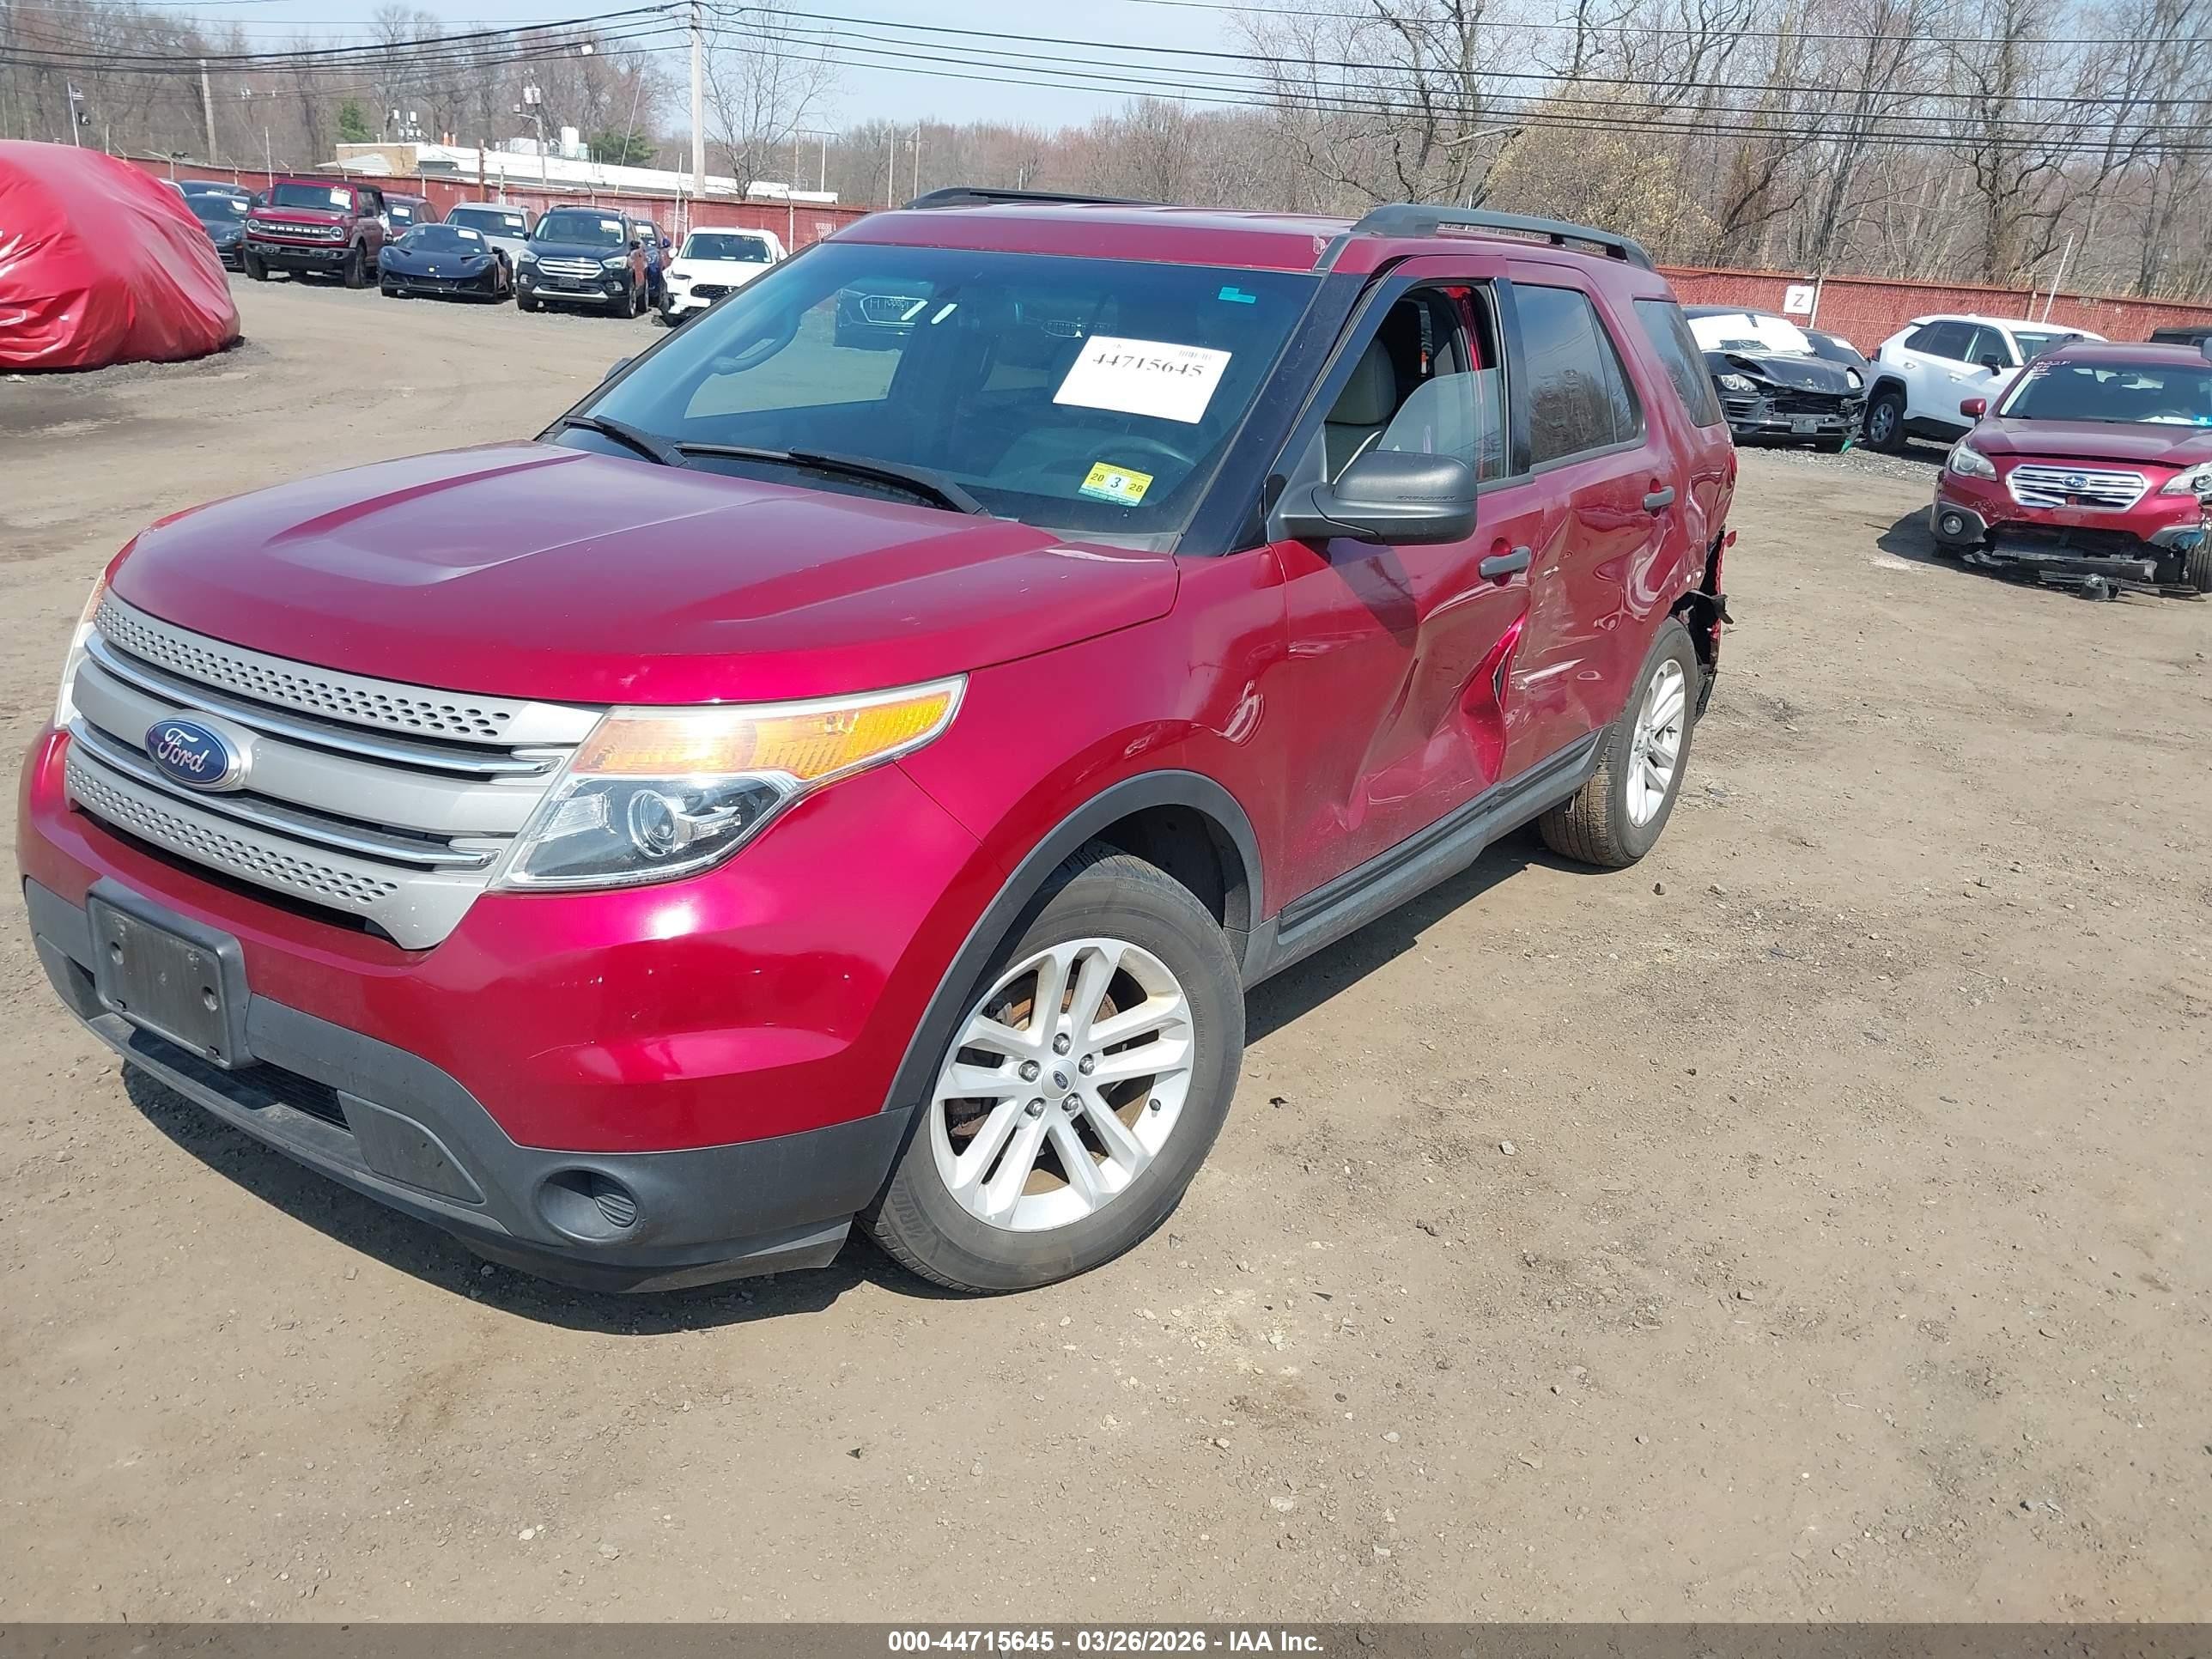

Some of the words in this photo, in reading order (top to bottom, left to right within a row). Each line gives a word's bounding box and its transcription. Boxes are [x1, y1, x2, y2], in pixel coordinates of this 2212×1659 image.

[1792, 294, 1805, 307] Z
[1093, 353, 1204, 376] 44715645
[1091, 472, 1105, 483] 20
[1110, 477, 1121, 489] 3
[1128, 483, 1144, 493] 28
[157, 727, 210, 773] Ford
